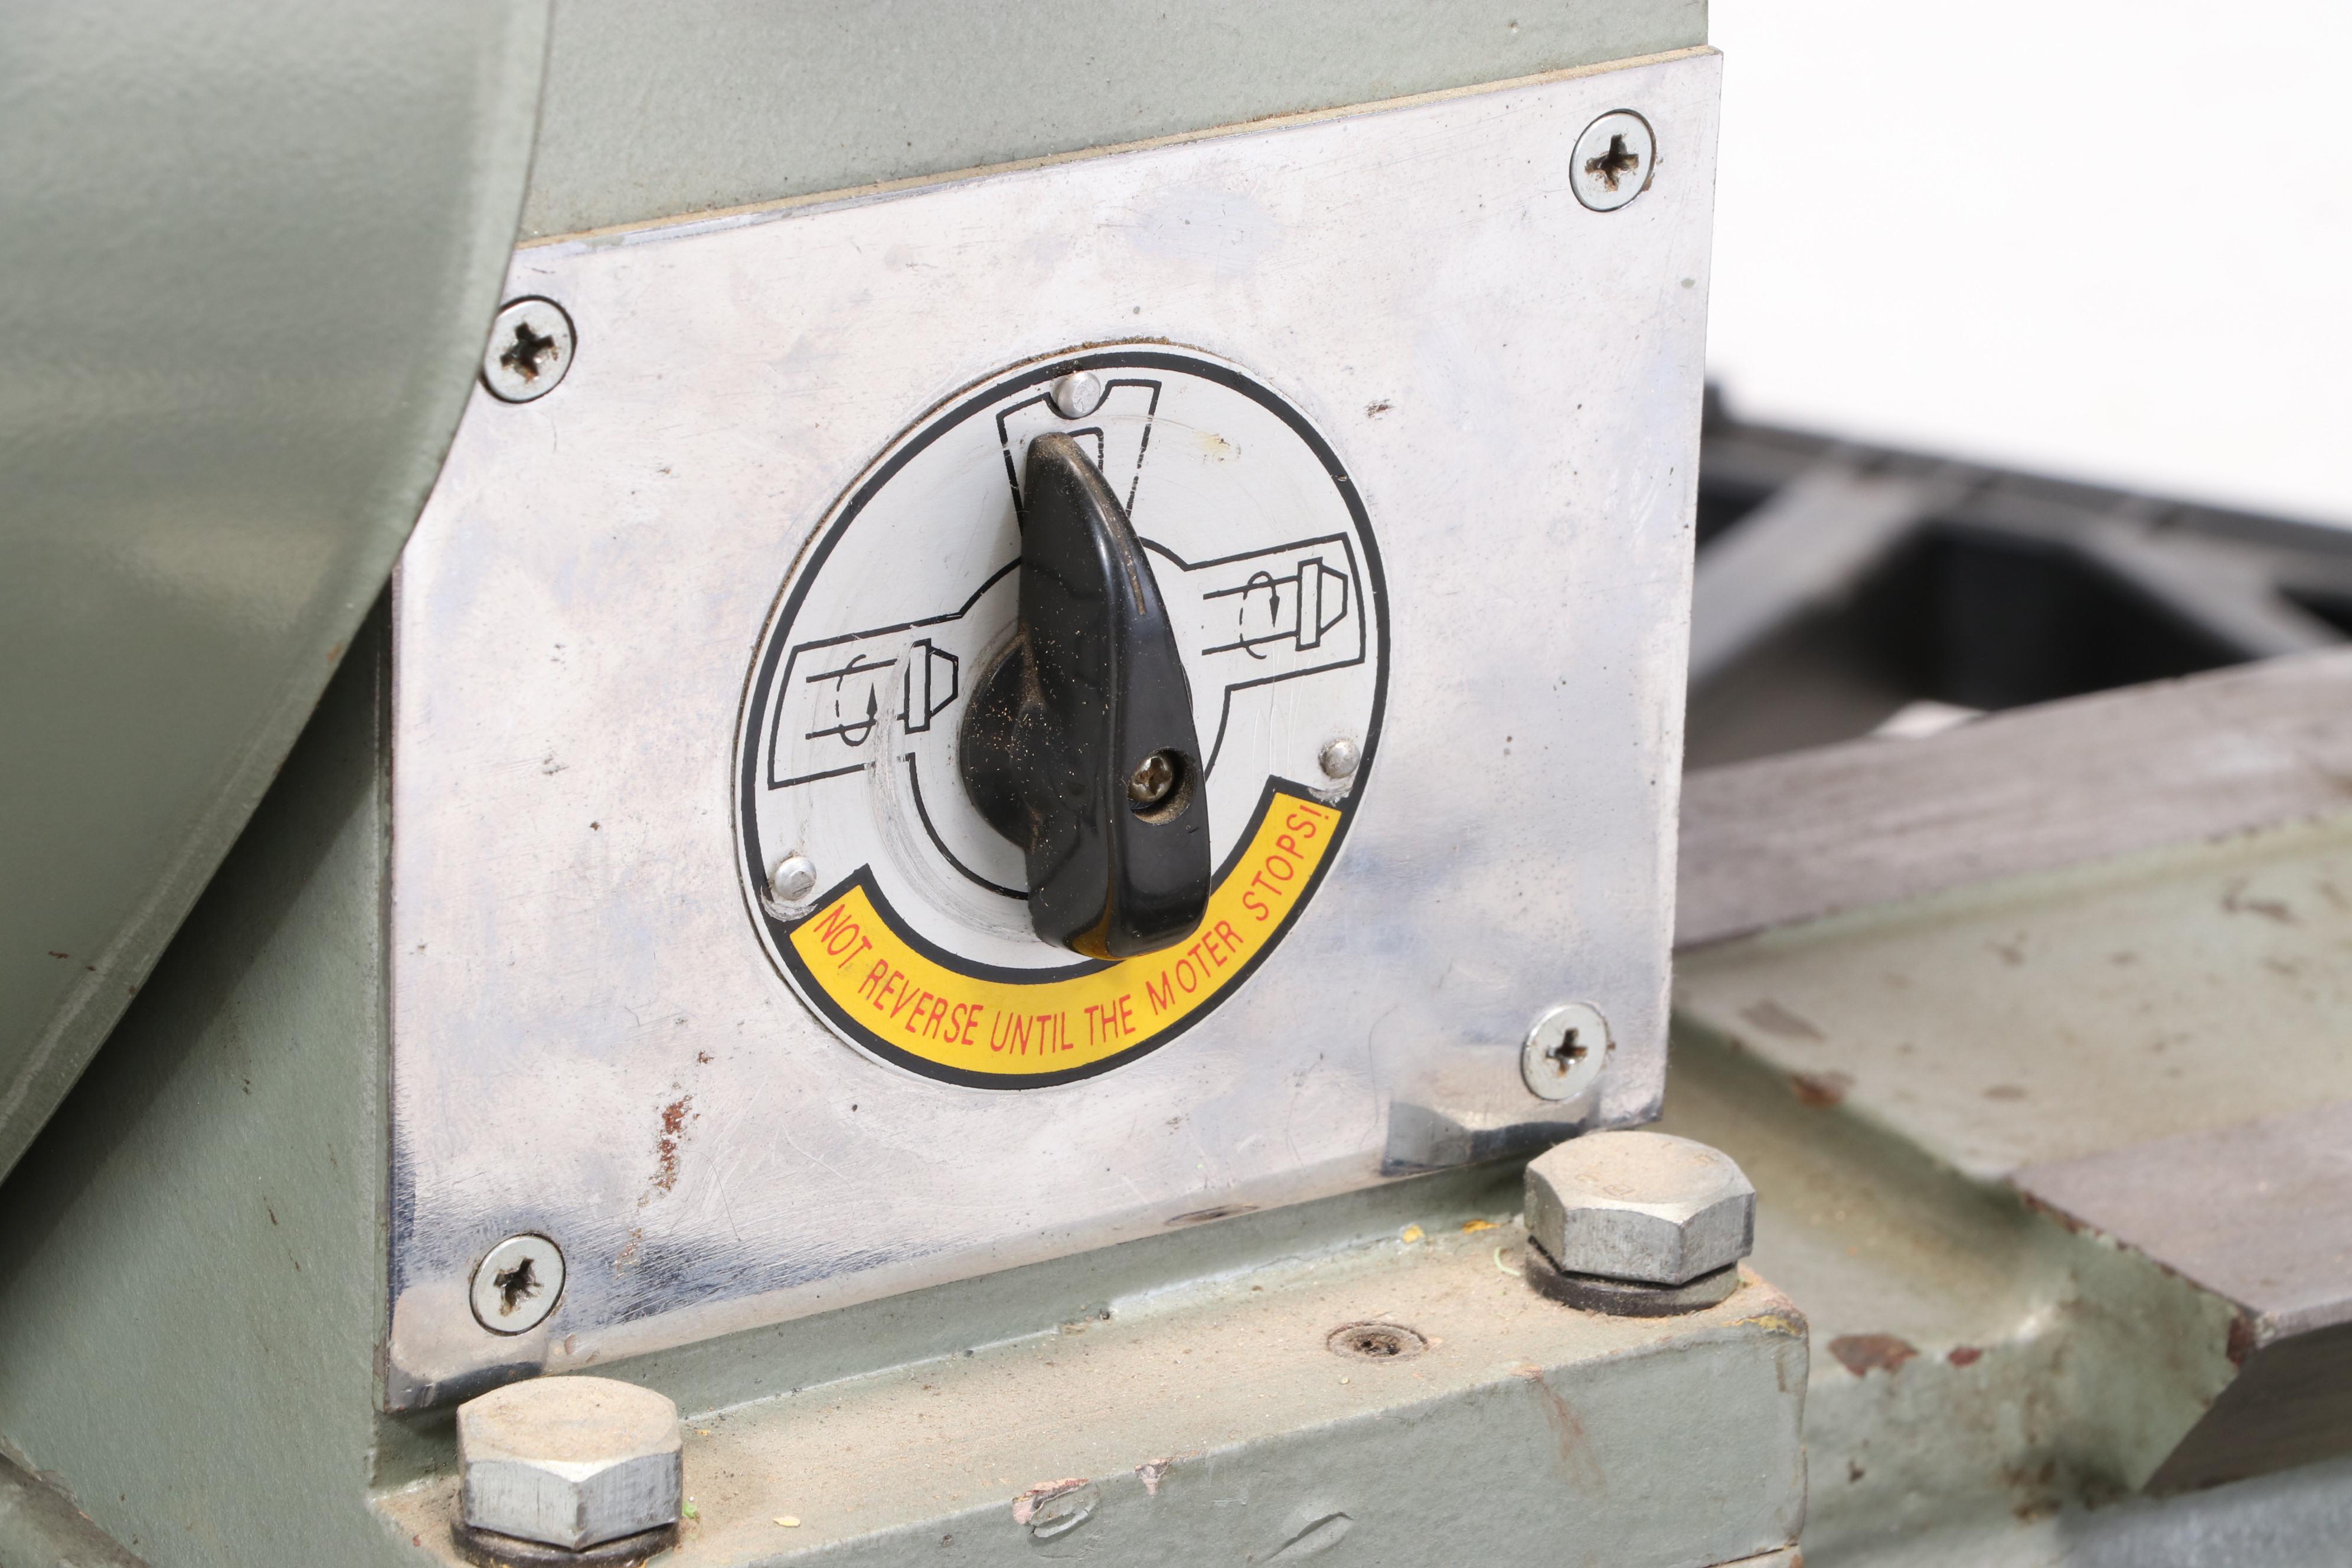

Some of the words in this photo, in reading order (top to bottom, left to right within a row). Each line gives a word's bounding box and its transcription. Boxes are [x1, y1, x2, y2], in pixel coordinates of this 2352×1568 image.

[814, 903, 873, 969] NOT
[858, 959, 984, 1046] REVERSE
[990, 1011, 1074, 1056] UNTIL
[1084, 994, 1136, 1043] THE
[1146, 920, 1244, 1015] MOTER
[1242, 804, 1330, 922] STOPS!
